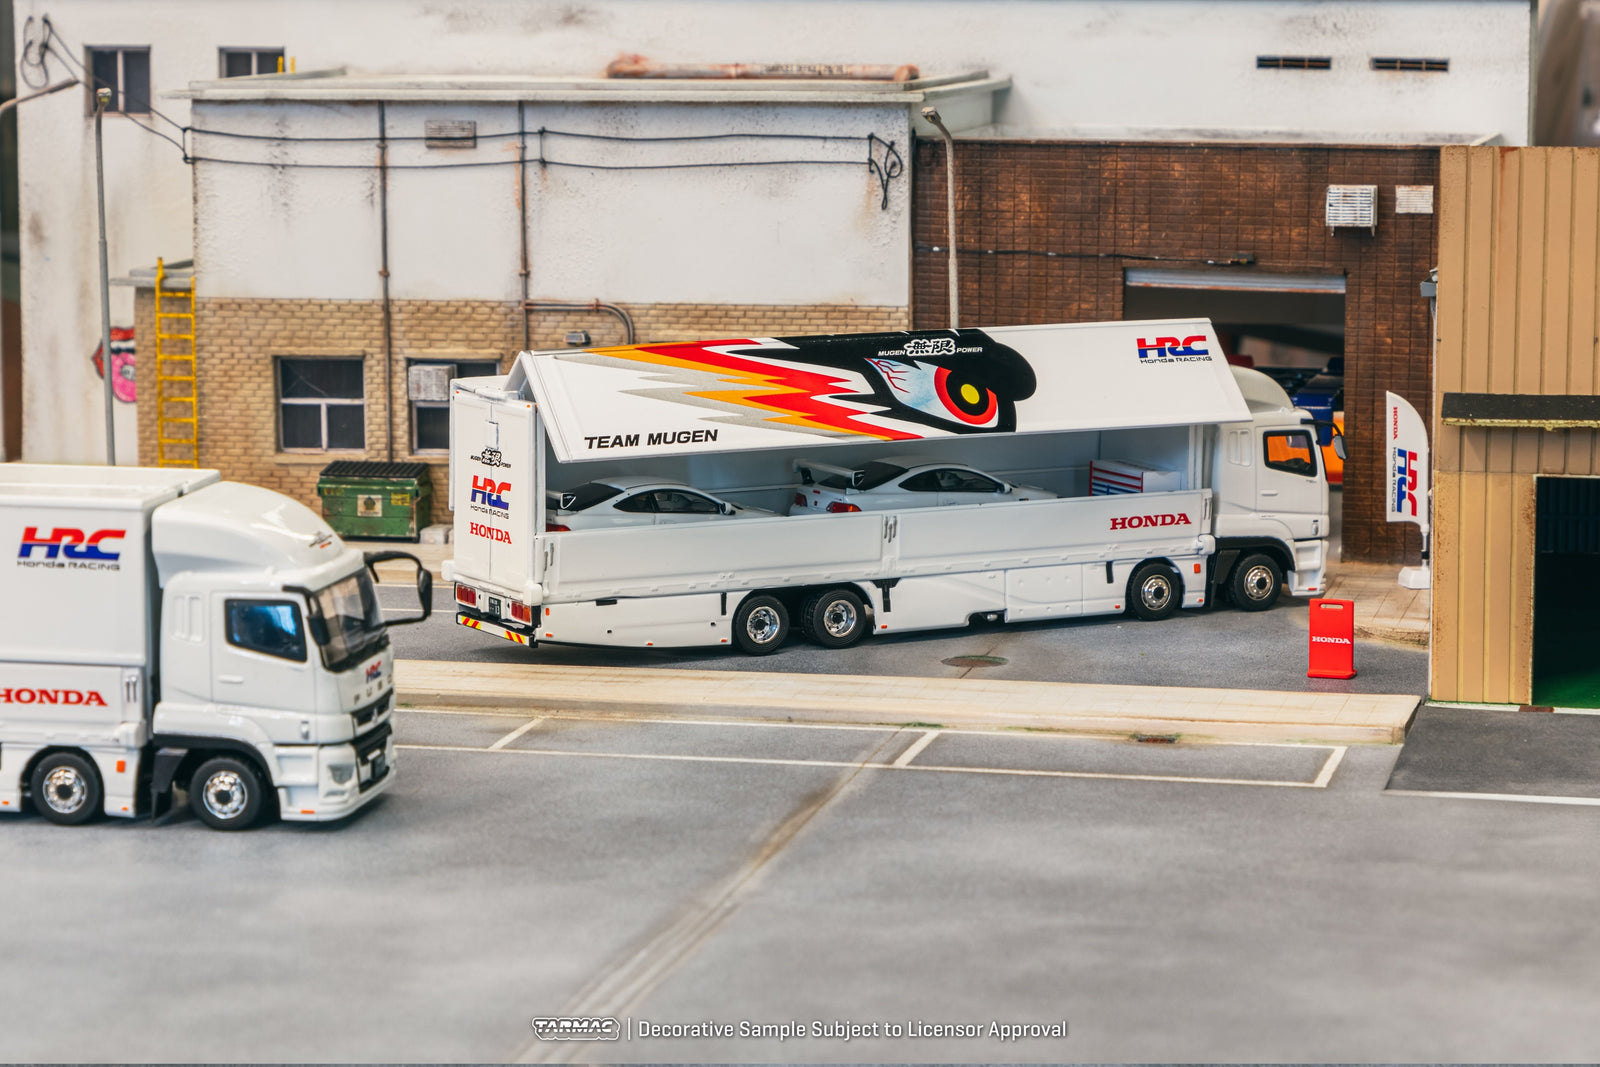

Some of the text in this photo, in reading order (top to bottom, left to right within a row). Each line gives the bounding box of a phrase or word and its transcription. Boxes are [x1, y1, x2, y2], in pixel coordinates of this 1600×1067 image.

[904, 338, 955, 356] 無限
[1136, 335, 1209, 358] HRC
[584, 429, 718, 449] TEAM MUGEN
[470, 475, 511, 510] HRC
[1396, 448, 1417, 517] HRC
[1110, 512, 1192, 530] HONDA
[18, 526, 126, 561] HRC
[470, 522, 512, 544] HONDA
[17, 560, 120, 571] Honda RACING
[1312, 636, 1351, 644] HONDA
